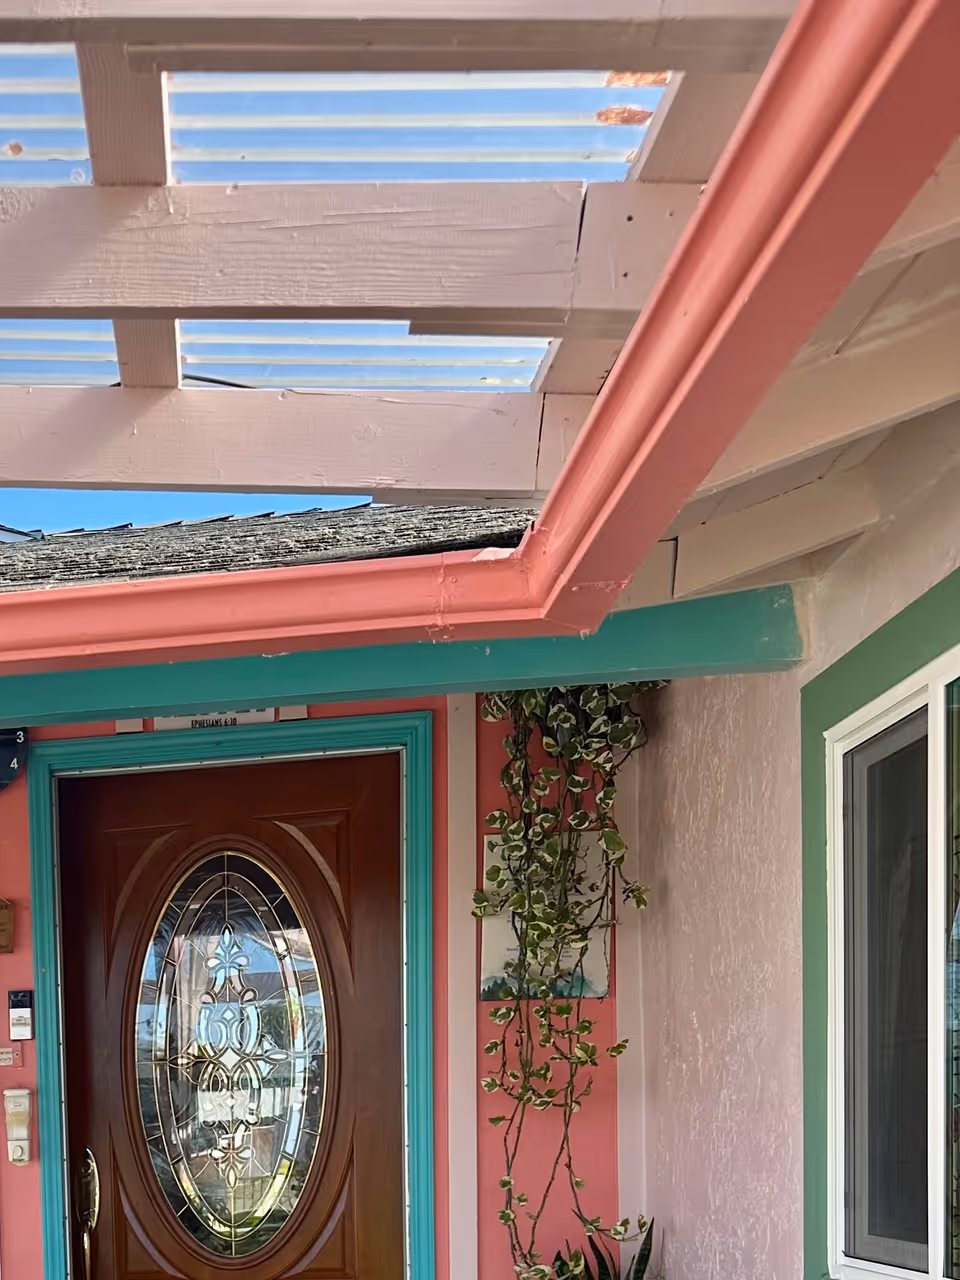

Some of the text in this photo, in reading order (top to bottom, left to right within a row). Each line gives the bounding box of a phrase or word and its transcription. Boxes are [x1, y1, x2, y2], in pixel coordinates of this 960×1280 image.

[191, 718, 223, 729] EPHESIANS
[16, 731, 24, 743] 3
[10, 758, 18, 770] 4
